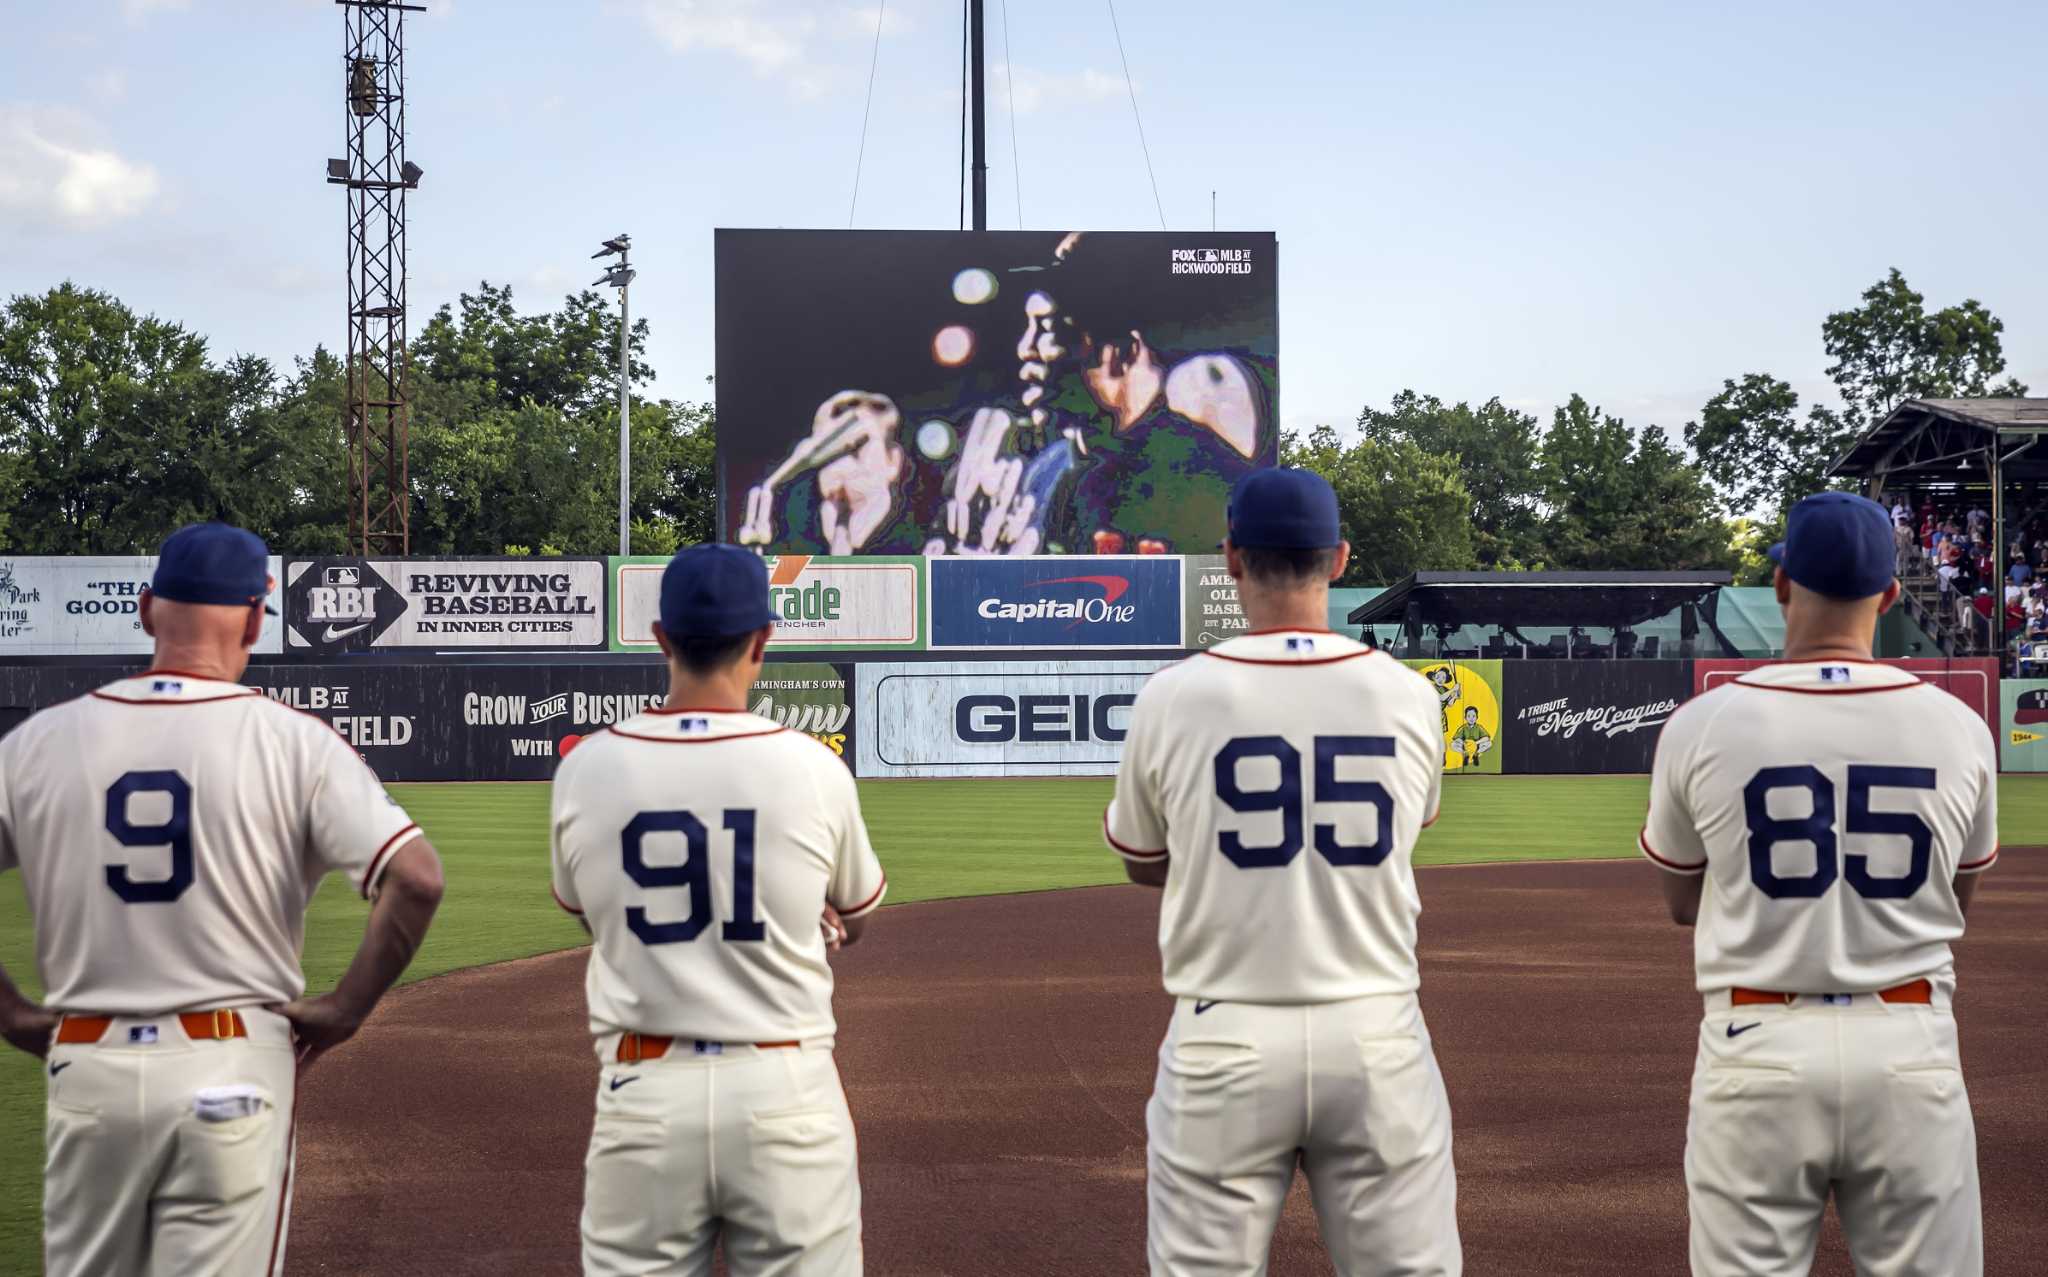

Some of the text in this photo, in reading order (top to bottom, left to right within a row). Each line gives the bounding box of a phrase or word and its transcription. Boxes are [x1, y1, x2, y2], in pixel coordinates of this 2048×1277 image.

[1172, 249, 1251, 261] FOX MLB AT
[1172, 262, 1251, 274] RICKWOOD FIELD
[409, 574, 571, 593] REVIVING
[8, 585, 41, 604] Park
[769, 580, 841, 621] rade
[66, 600, 139, 614] GOOD
[307, 587, 377, 622] RBI
[424, 596, 596, 615] BASEBALL
[1203, 604, 1242, 614] BASE
[416, 621, 574, 633] IN INNER CITIES
[822, 680, 845, 689] OWN
[267, 687, 348, 709] MLB AT
[1527, 697, 1569, 716] TRIBUTE
[464, 691, 526, 725] GROW
[532, 696, 567, 721] YOUR
[1537, 698, 1679, 739] Negro Leagues
[332, 716, 413, 746] FIELD
[511, 738, 553, 756] WITH
[1214, 735, 1396, 869] 95
[105, 770, 195, 903] 9
[1743, 764, 1936, 899] 85
[621, 809, 766, 945] 91
